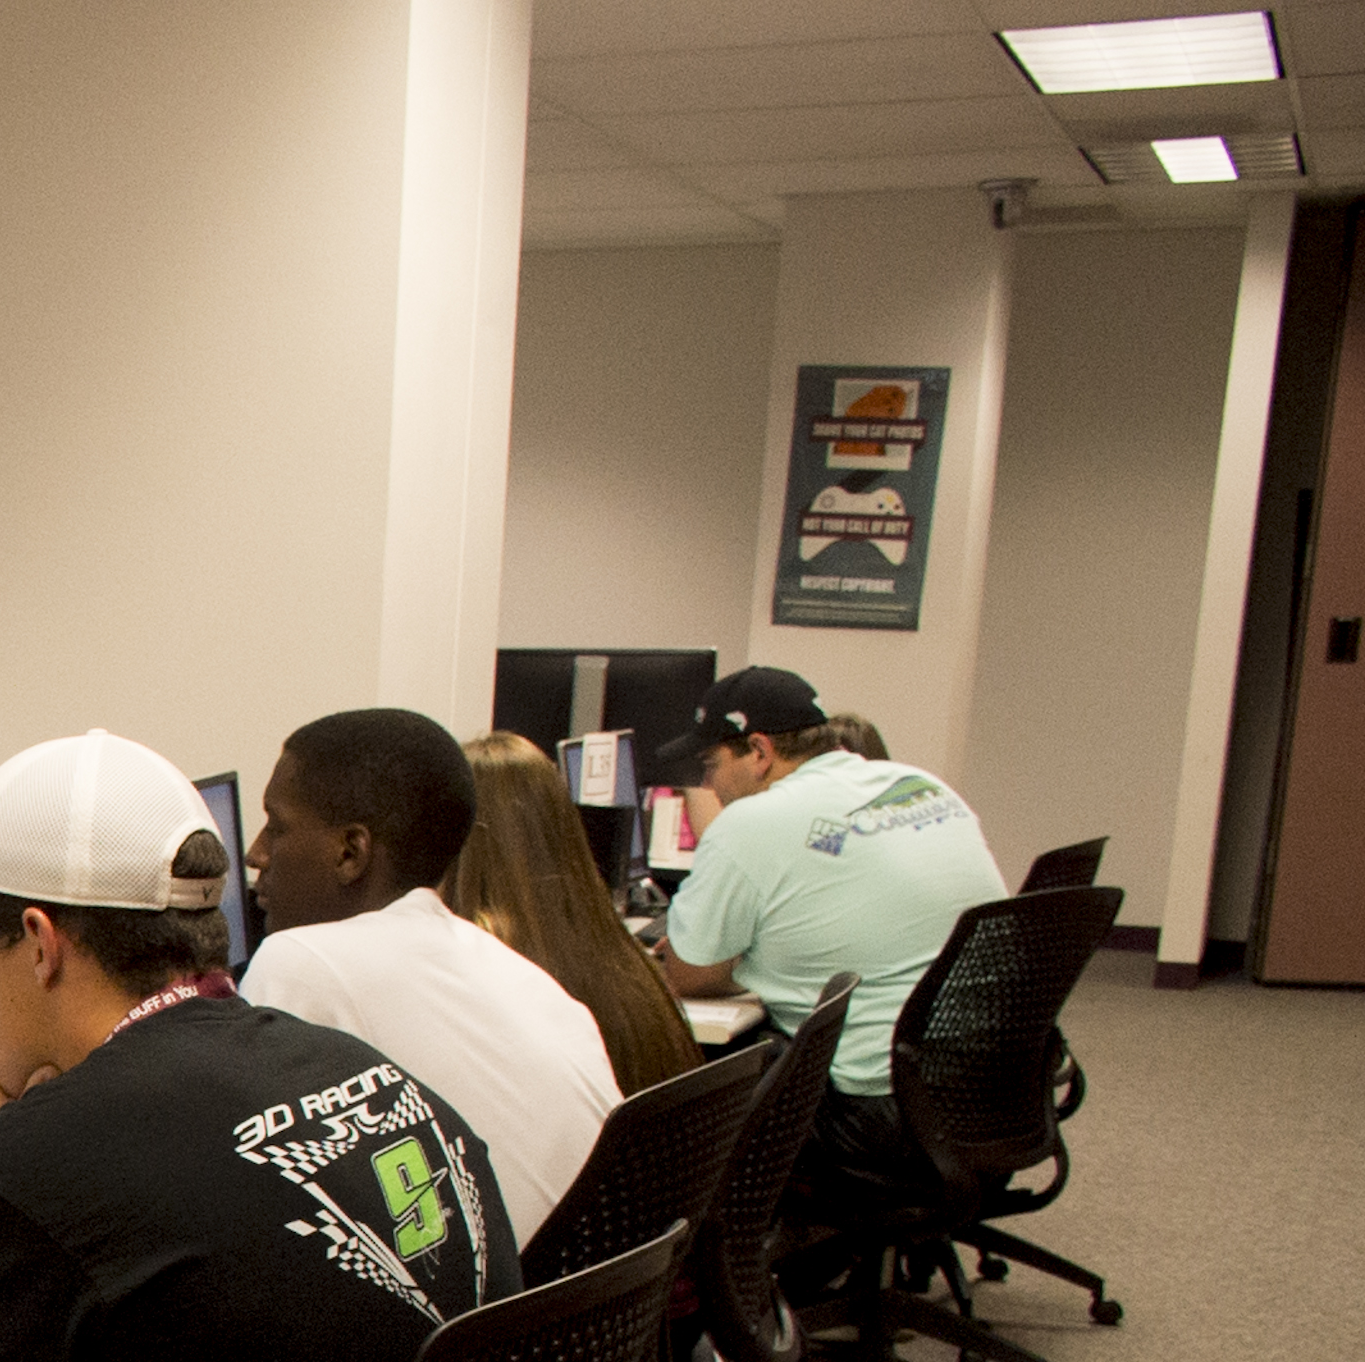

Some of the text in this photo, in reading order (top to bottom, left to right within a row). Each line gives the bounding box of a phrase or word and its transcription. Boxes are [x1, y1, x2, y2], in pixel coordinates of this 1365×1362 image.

[129, 994, 162, 1020] BUFF
[161, 991, 177, 1005] in
[172, 984, 199, 1000] You
[232, 1063, 404, 1153] 3D RACING
